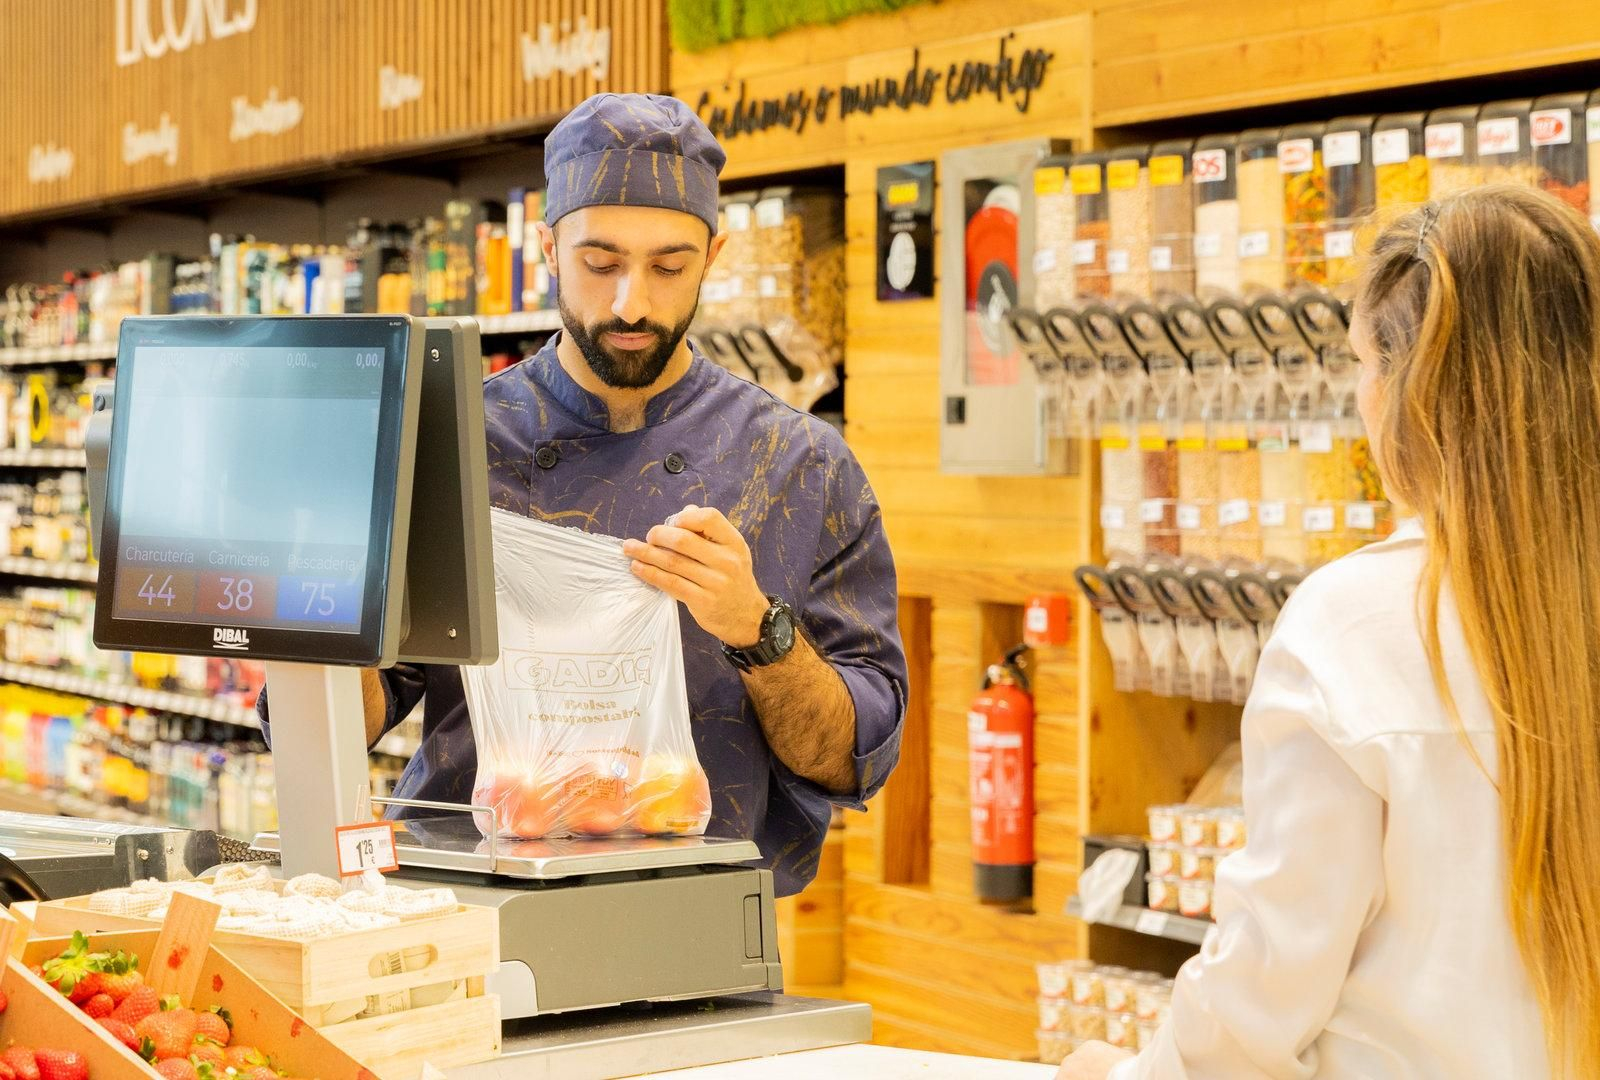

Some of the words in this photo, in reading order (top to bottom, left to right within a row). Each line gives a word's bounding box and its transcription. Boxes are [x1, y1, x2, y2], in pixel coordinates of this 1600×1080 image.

[840, 47, 942, 121] mundo
[946, 31, 1055, 113] contigo
[355, 352, 378, 369] 0,00
[126, 546, 194, 563] Charcutería
[208, 550, 270, 567] Carnicería
[287, 553, 356, 571] Pescadería
[137, 574, 176, 606] 44
[216, 577, 254, 611] 38
[301, 581, 336, 616] 75
[213, 628, 249, 643] DIBAL
[564, 699, 617, 711] Bolsa
